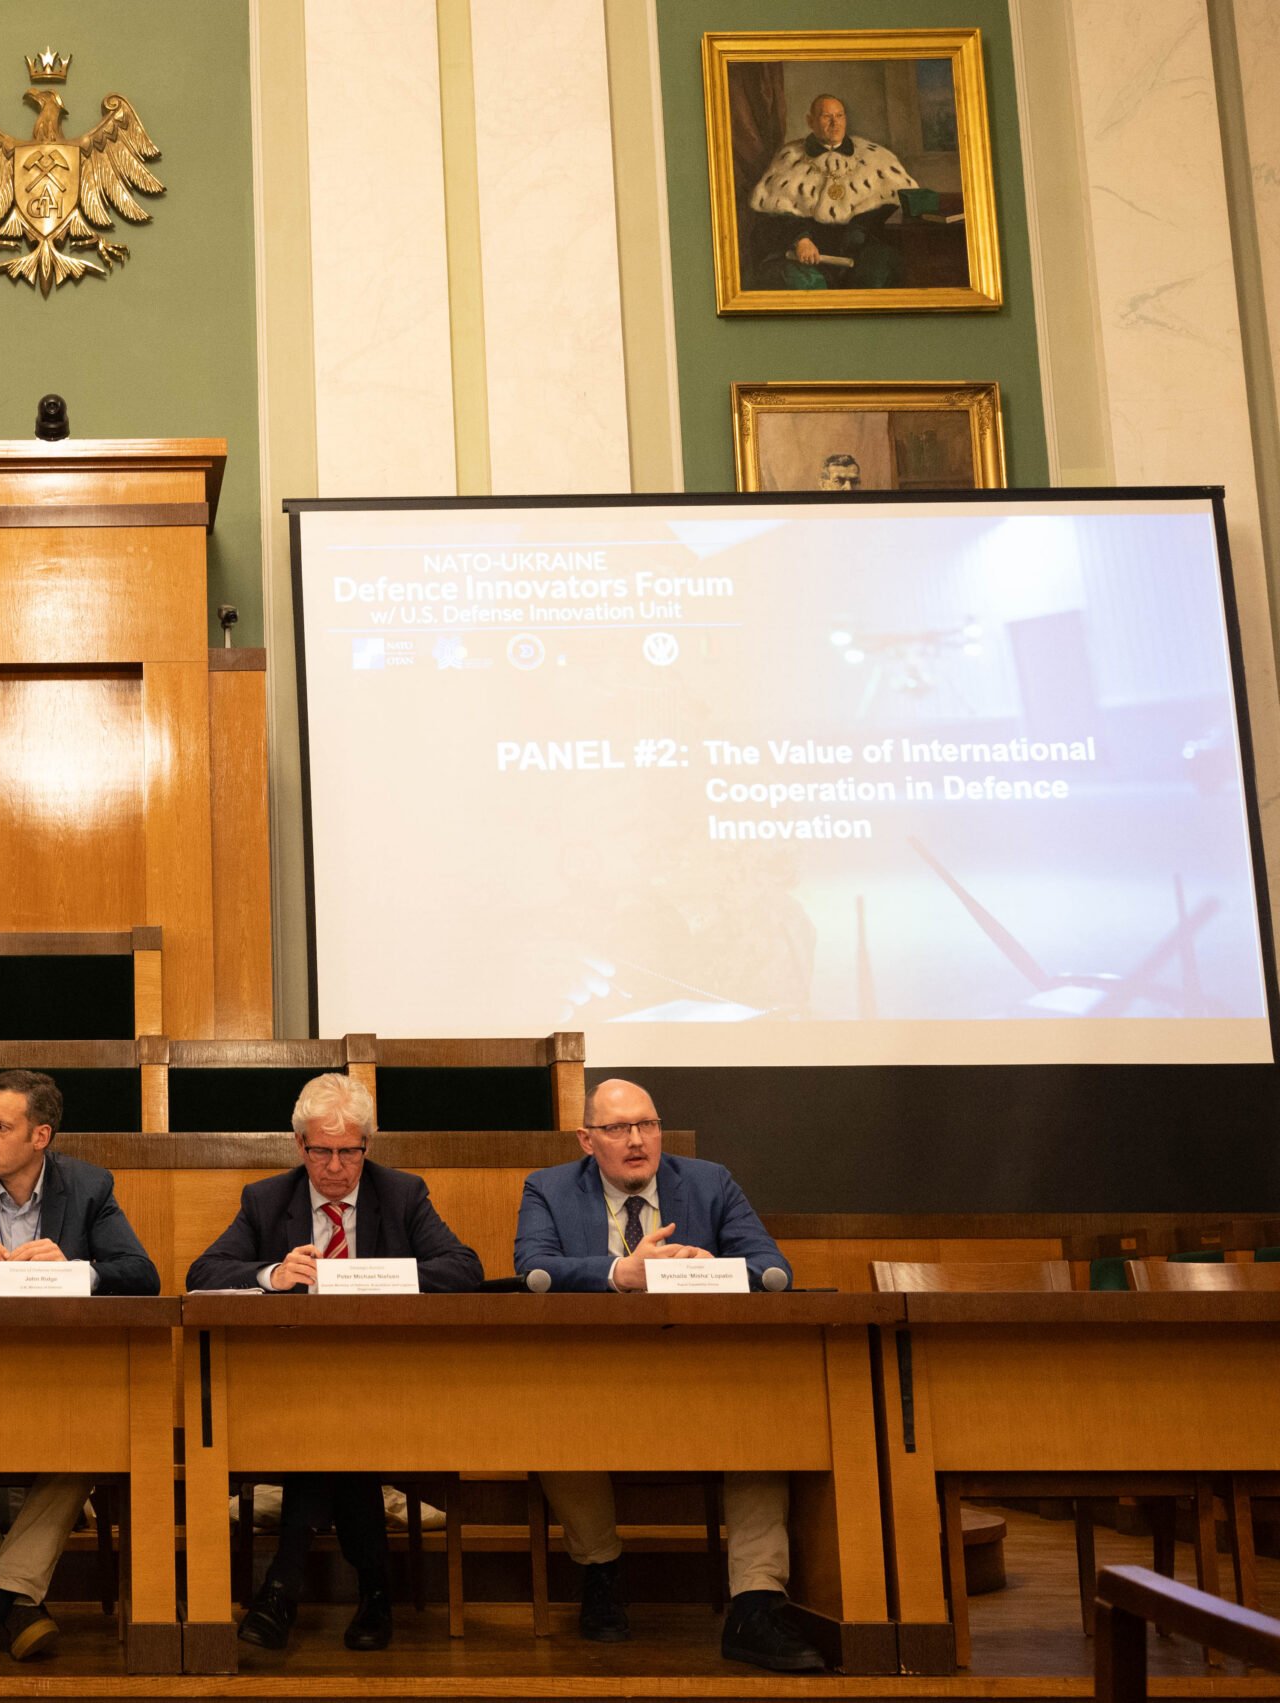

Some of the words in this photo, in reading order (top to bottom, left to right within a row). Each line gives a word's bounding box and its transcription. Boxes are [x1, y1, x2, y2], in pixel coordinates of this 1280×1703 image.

[423, 552, 607, 573] NATO-UKRAINE
[334, 577, 458, 602] Defence
[466, 574, 627, 600] Innovators
[636, 572, 733, 597] Forum
[370, 609, 395, 624] w/
[401, 608, 438, 623] U.S.
[444, 606, 523, 622] Defense
[530, 604, 634, 620] Innovation
[640, 602, 681, 618] Unit
[496, 740, 624, 770] PANEL
[634, 739, 688, 767] #2:
[704, 740, 760, 765] The
[768, 740, 852, 764] Value
[862, 739, 894, 763] of
[902, 737, 1095, 762] International
[706, 777, 895, 808] Cooperation
[906, 776, 933, 800] in
[943, 775, 1069, 800] Defence
[709, 815, 871, 840] Innovation
